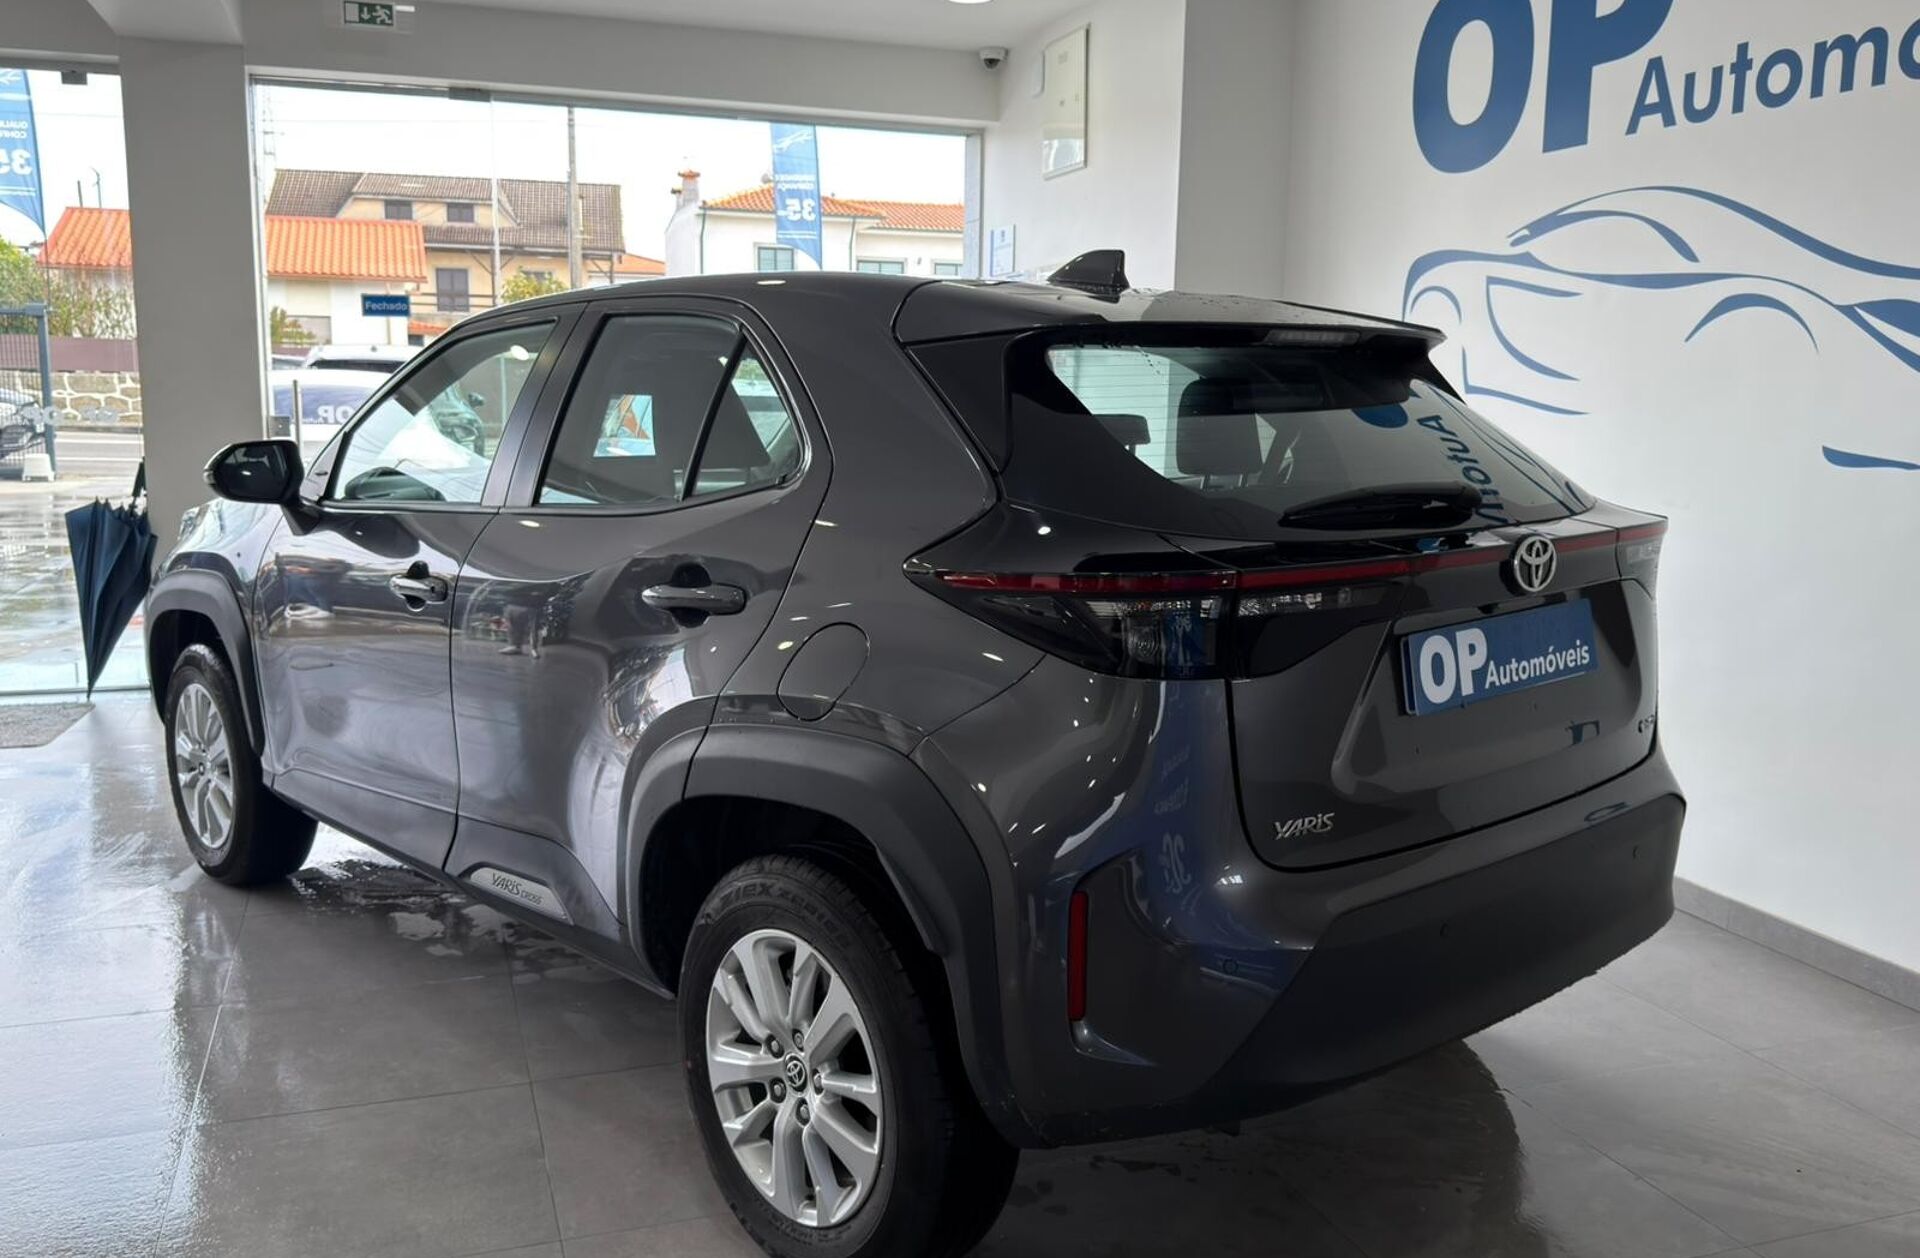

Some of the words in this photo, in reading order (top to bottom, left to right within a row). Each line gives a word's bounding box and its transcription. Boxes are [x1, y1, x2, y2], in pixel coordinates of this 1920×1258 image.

[1412, 0, 1675, 174] OP
[365, 301, 408, 311] Fechado
[1419, 628, 1488, 705] OP
[1485, 639, 1590, 690] Automóveis
